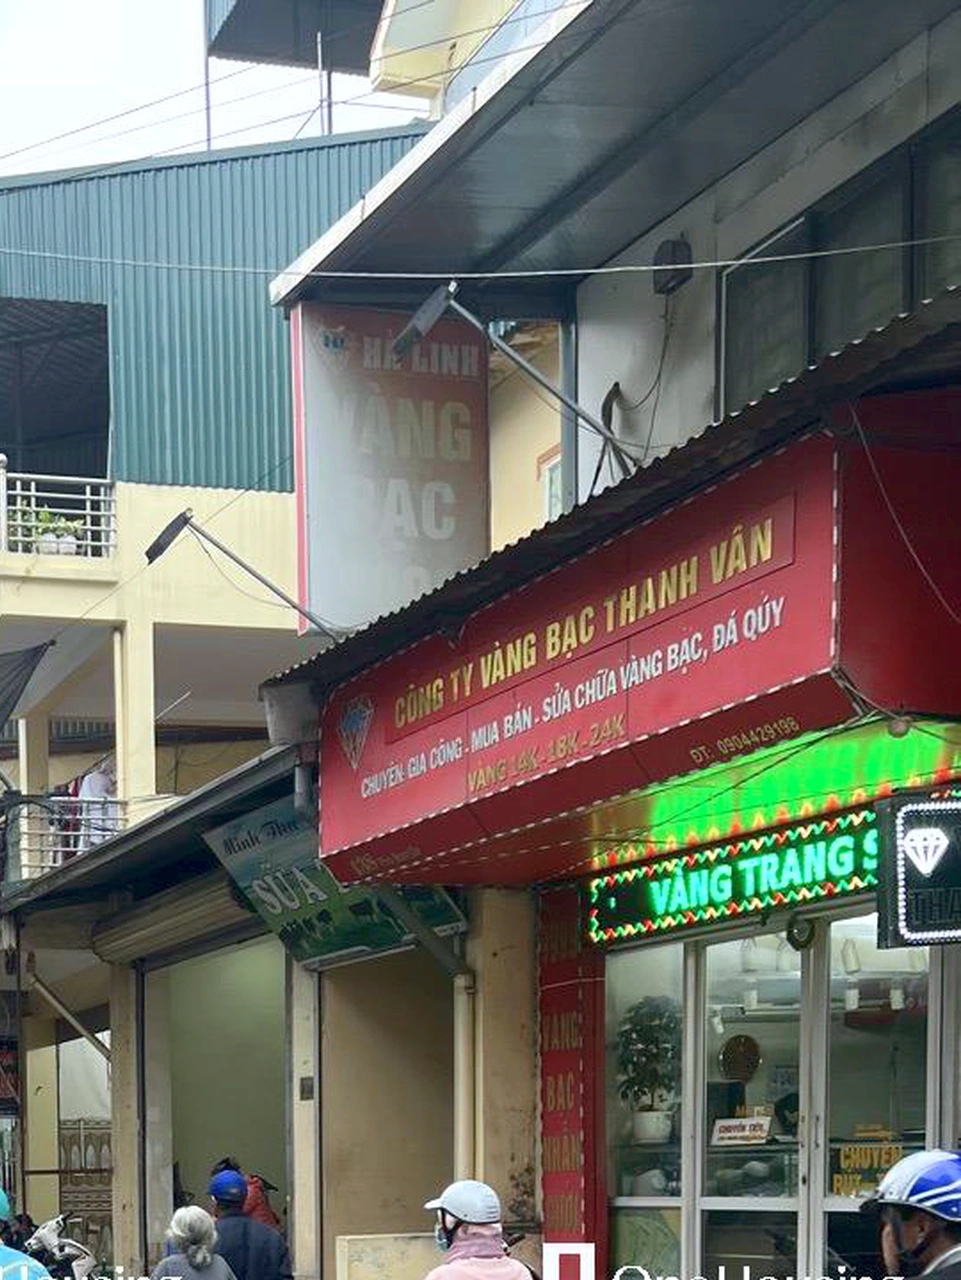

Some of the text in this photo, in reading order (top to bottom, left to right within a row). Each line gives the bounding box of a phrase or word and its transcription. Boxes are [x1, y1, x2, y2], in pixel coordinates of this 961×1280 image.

[395, 518, 773, 729] CÔNG TY VÀNG BẠC THANH VÂN
[471, 722, 500, 756] MUA
[504, 703, 533, 739] BÁN
[542, 682, 572, 723] SỬA
[620, 655, 664, 690] VÀNG
[712, 609, 739, 654] ĐÁ
[649, 864, 732, 917] VÀNG
[737, 835, 855, 898] TRANG
